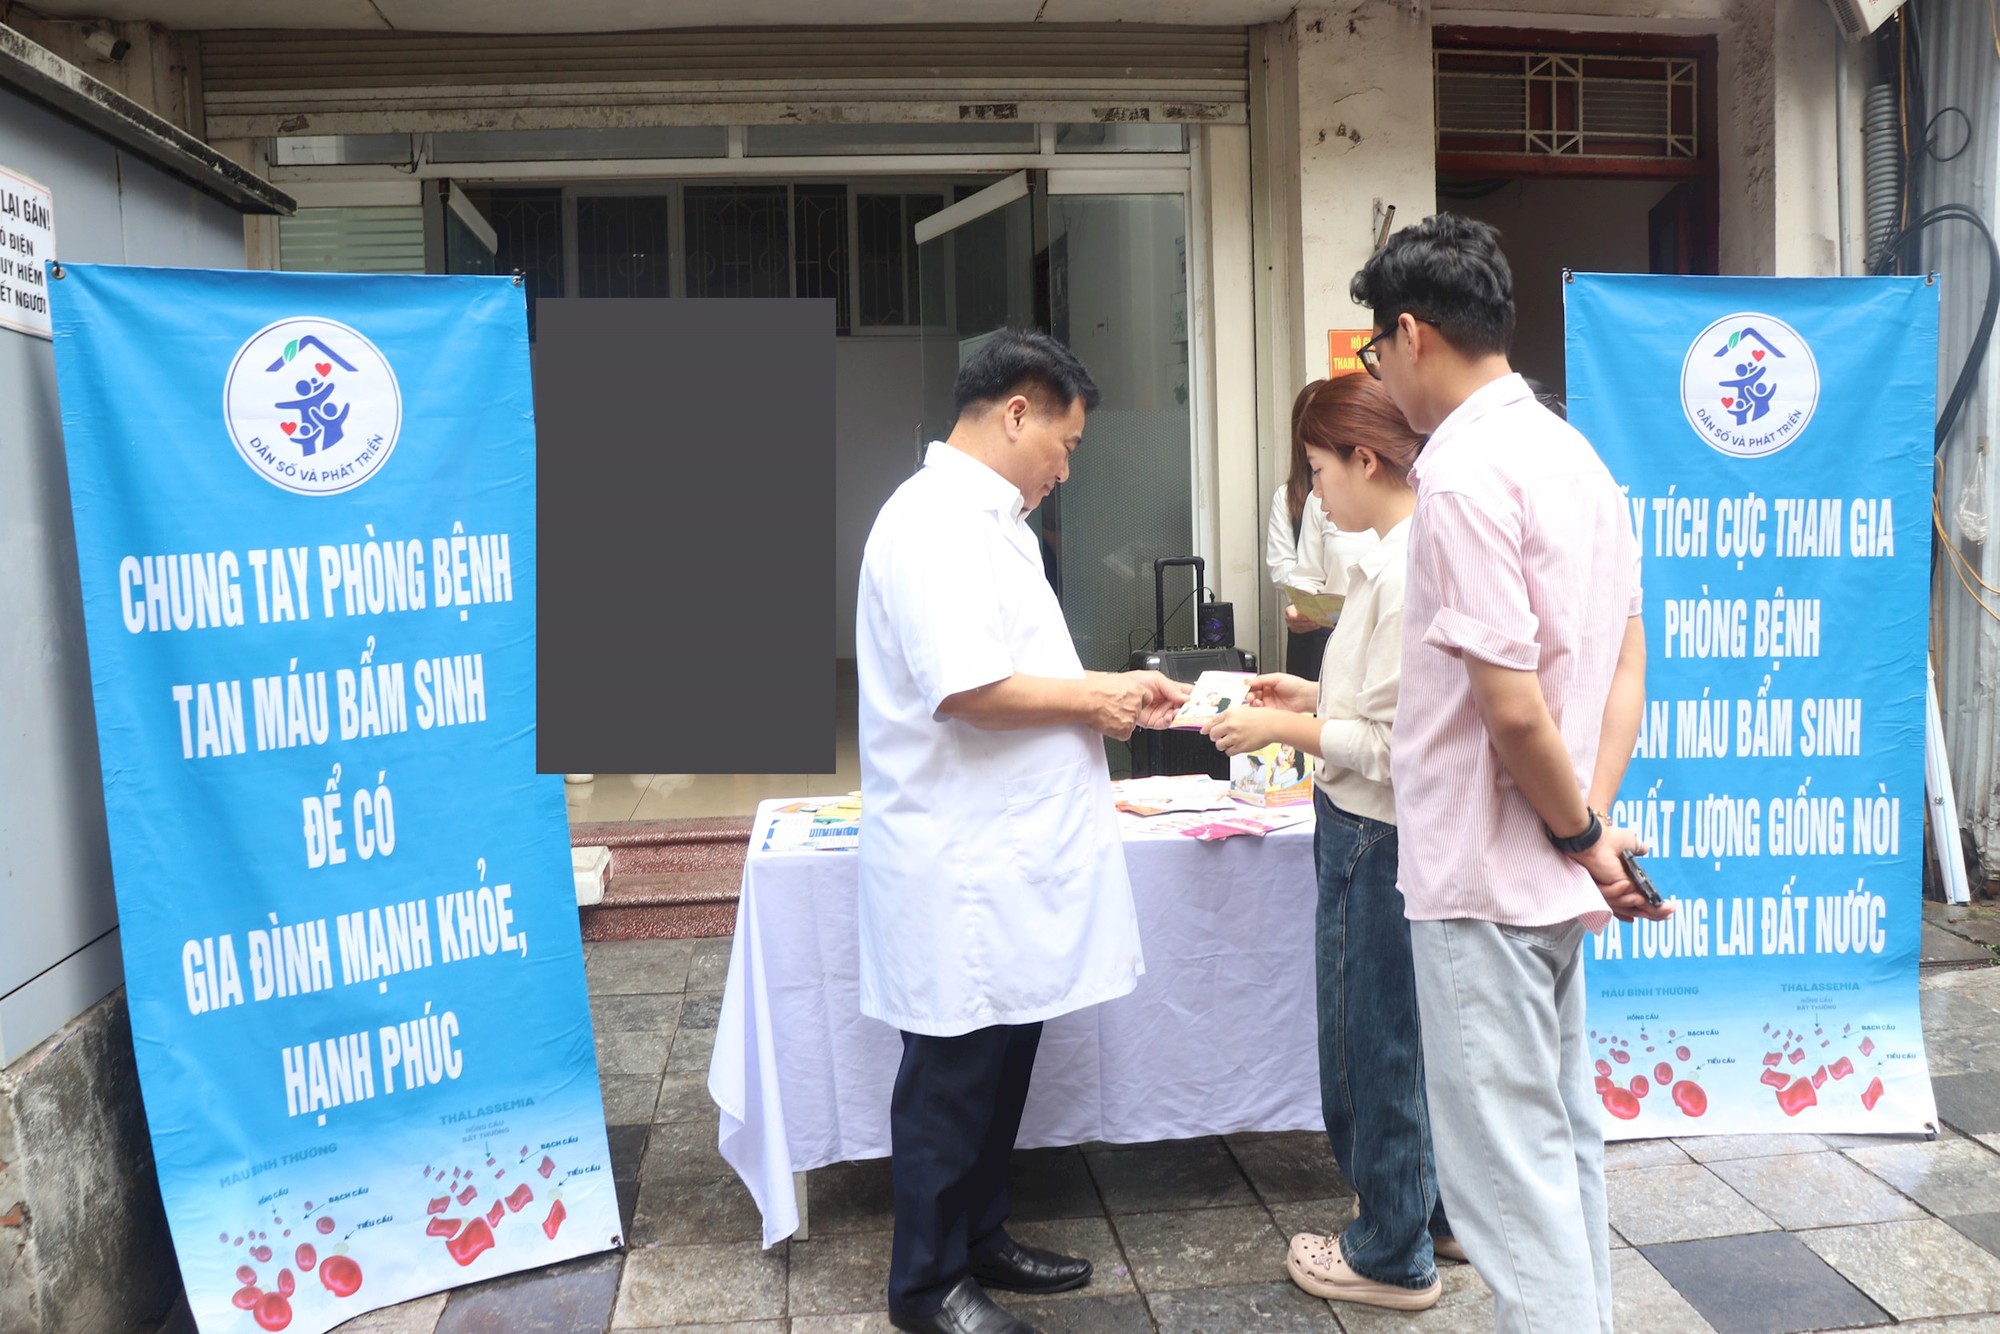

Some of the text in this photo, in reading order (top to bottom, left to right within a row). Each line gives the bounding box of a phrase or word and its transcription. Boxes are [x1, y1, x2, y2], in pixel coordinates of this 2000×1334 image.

[1, 189, 20, 221] LẠI
[9, 232, 34, 257] ĐIỆN
[1333, 357, 1355, 370] THAM
[250, 433, 384, 482] DÂN SỐ VÀ PHÁT TRIỂN
[1696, 408, 1803, 447] DÂN SỐ VÀ PHÁT TRIỂN
[1652, 484, 1709, 558] TÍCH
[1715, 492, 1767, 571] CỰC
[1774, 498, 1842, 558] THAM
[1850, 498, 1894, 558] GIA
[119, 521, 513, 634] CHUNG TAY PHÒNG BỆNH
[1664, 584, 1820, 671] PHÒNG BỆNH
[172, 634, 487, 760] TAN MÁU BẨM SINH
[1630, 674, 1862, 759] AN MÁU BẨM SINH
[302, 762, 396, 870] ĐỂ CÓ
[1680, 793, 1760, 872] LƯỢNG
[1768, 776, 1845, 857] GIỐNG
[1853, 782, 1899, 855] NÒI
[182, 857, 527, 1016] GIA ĐÌNH MẠNH KHỎE,
[1716, 897, 1753, 956] LAI
[1761, 875, 1808, 955] ĐẤT
[1815, 878, 1886, 955] NƯỚC
[1781, 982, 1860, 993] THALASSEMIA
[282, 1000, 463, 1127] HẠNH PHÚC
[439, 1097, 535, 1126] THALASSEMIA
